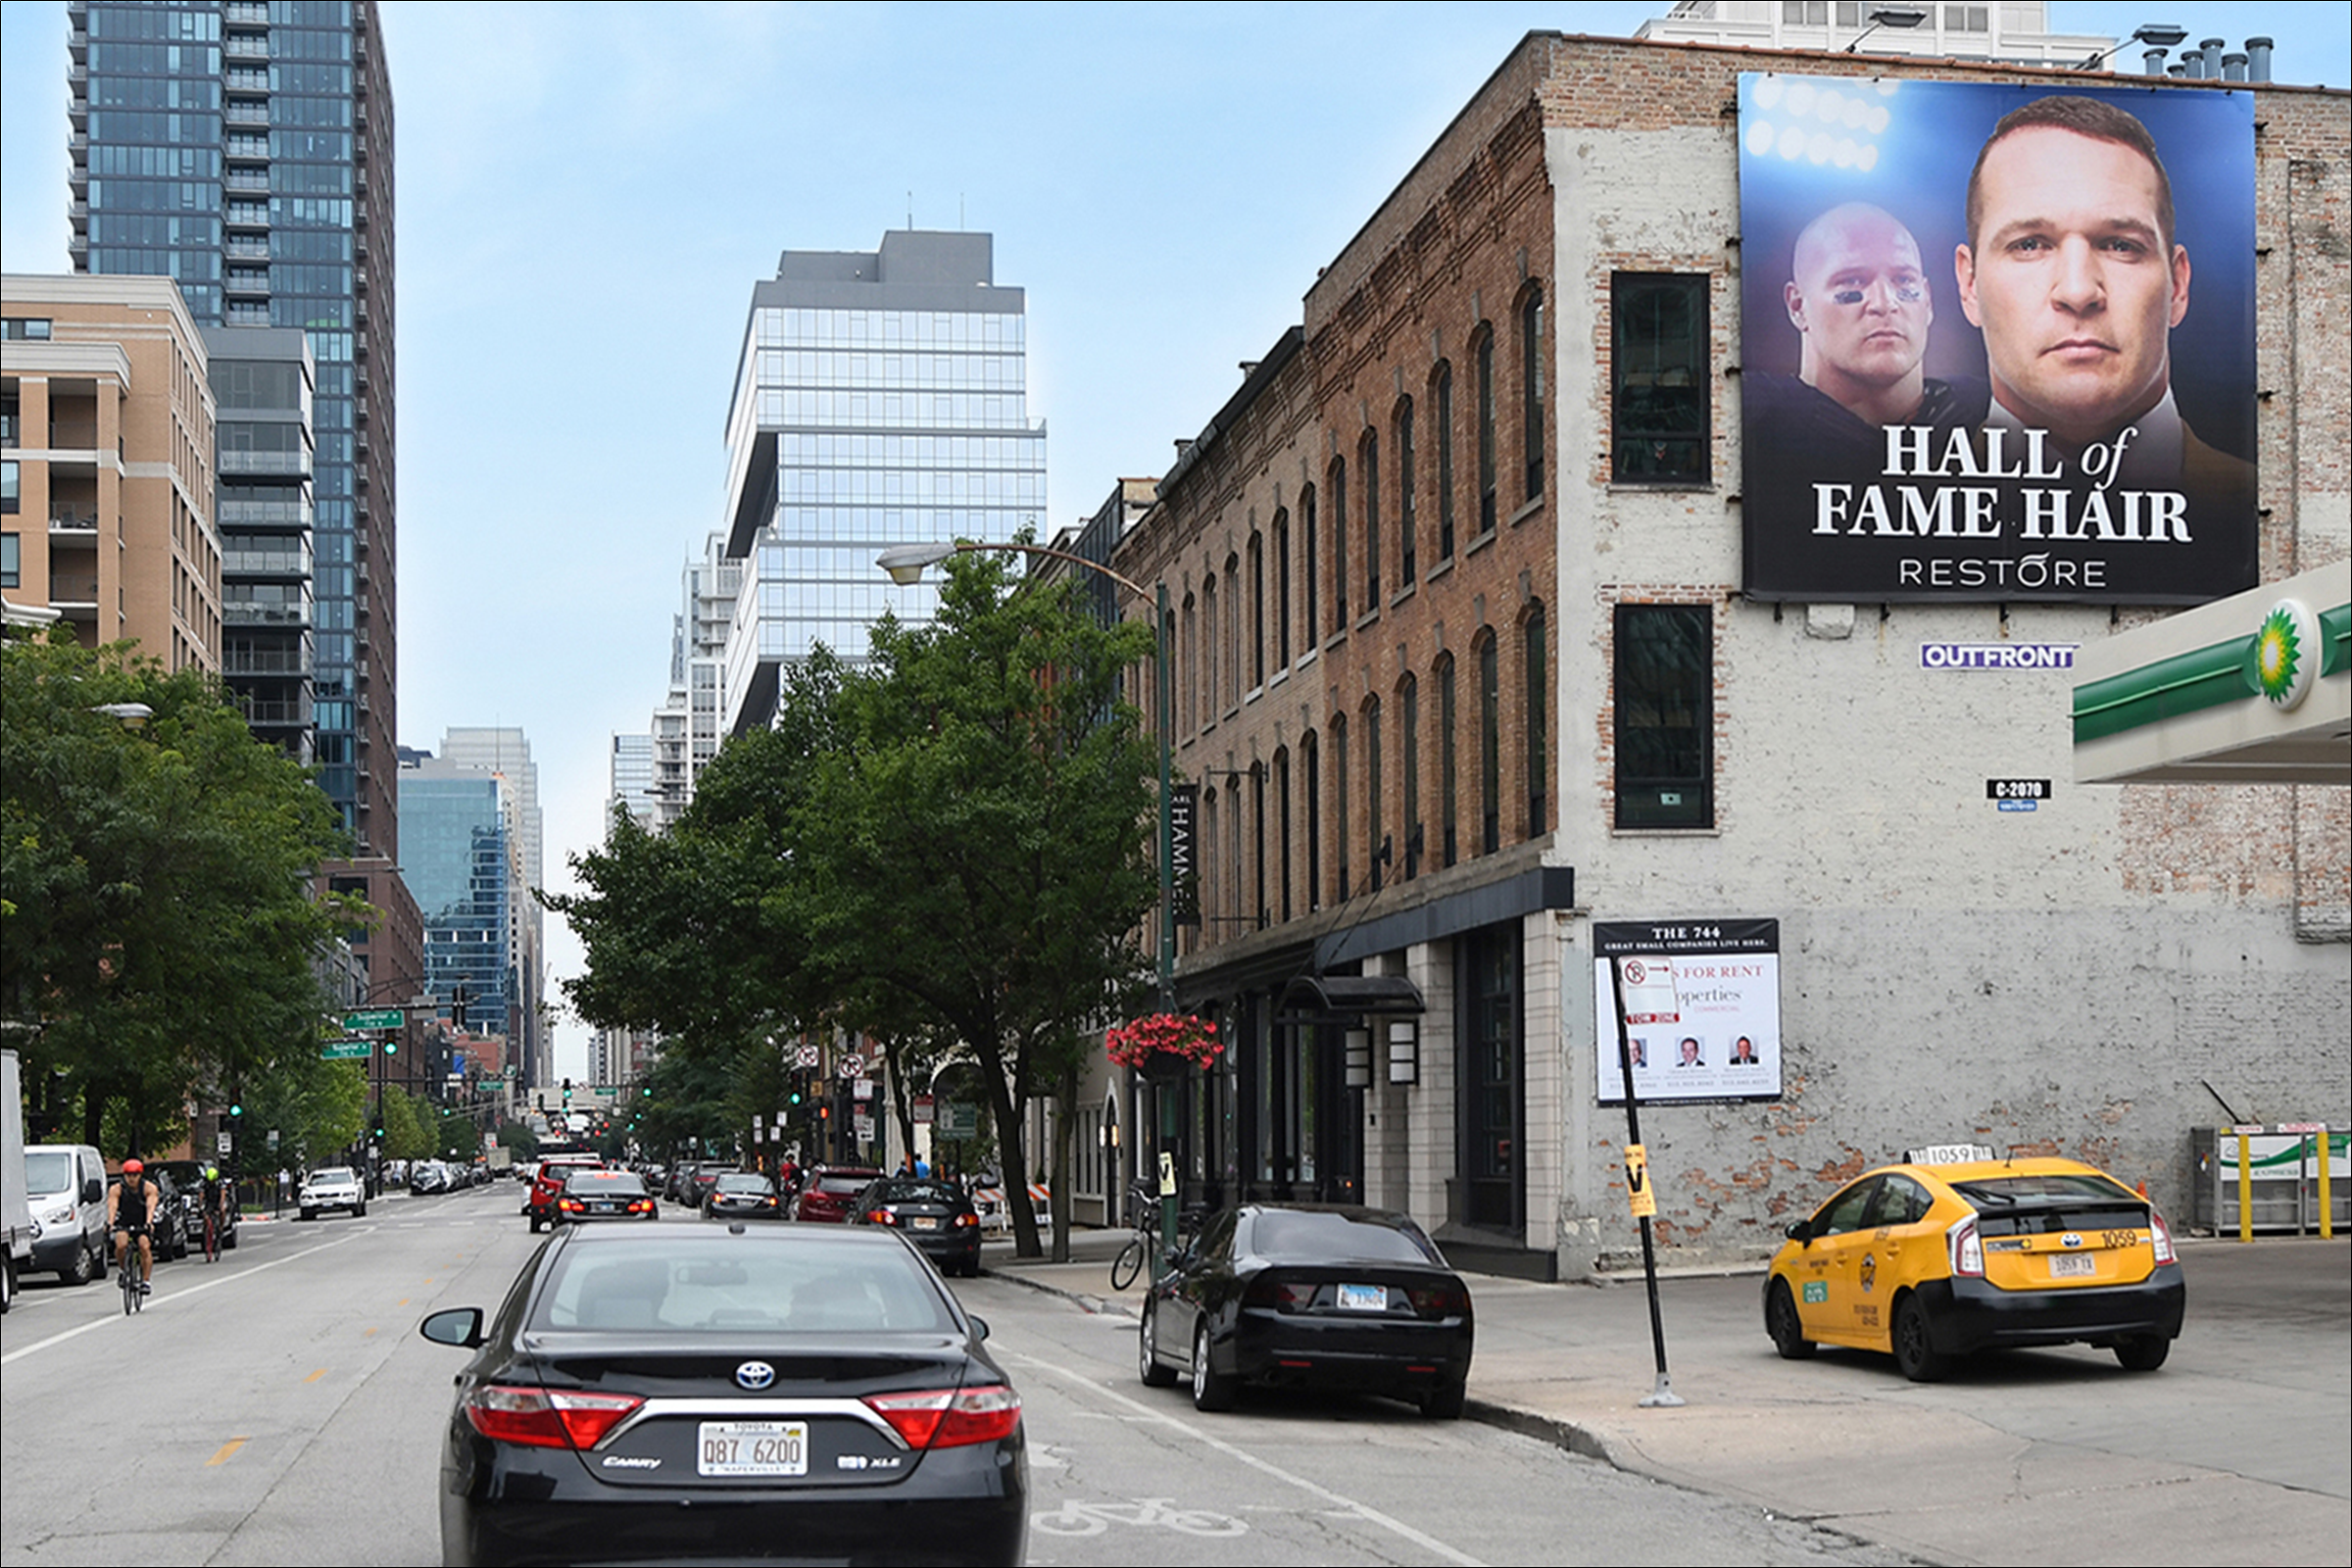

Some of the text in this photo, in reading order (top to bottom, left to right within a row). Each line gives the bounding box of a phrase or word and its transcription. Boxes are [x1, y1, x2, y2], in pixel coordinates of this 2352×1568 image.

[1882, 424, 2138, 489] HALL of
[1811, 483, 2193, 543] FAME HAIR
[1925, 646, 2075, 668] OUTFRONT
[1995, 781, 2042, 798] C-2070
[1651, 926, 1721, 941] THE 744
[1604, 942, 1635, 951] GREAT
[1636, 941, 1664, 951] SMALL
[1666, 940, 1717, 950] COMPANIES
[1720, 939, 1740, 948] LIVE
[1683, 965, 1716, 979] FOR
[1720, 964, 1764, 978] RENT
[1675, 985, 1742, 1007] operties
[1932, 1147, 1970, 1163] 1059
[2101, 1229, 2137, 1249] 1059
[704, 1439, 801, 1464] Q87 6200
